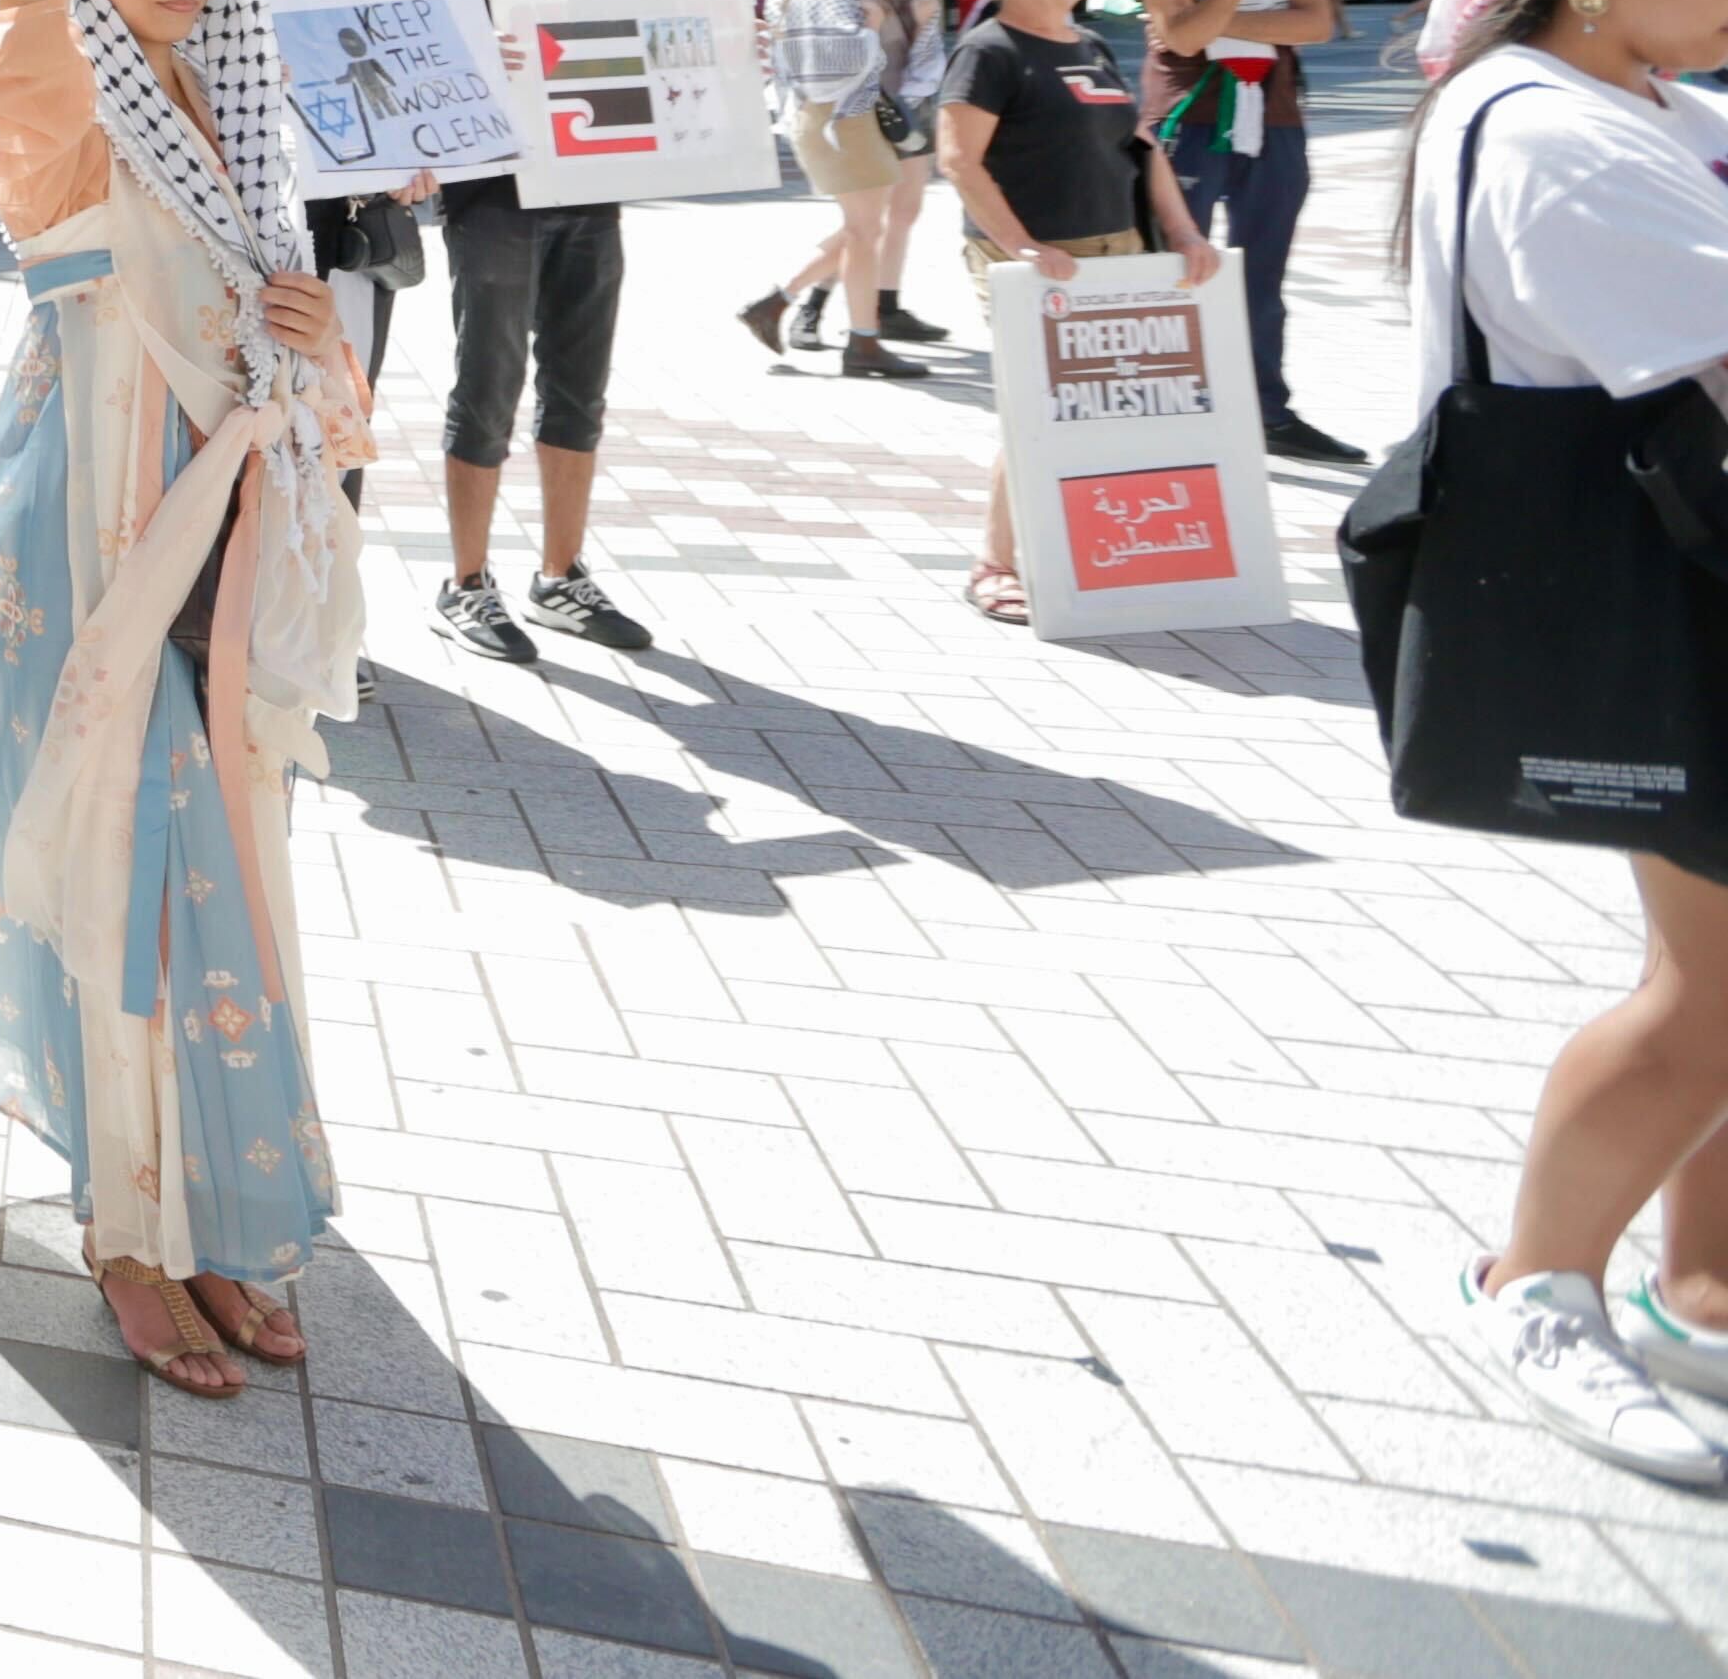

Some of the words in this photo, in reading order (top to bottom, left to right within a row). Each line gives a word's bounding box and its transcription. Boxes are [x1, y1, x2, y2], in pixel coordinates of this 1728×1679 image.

[384, 42, 449, 74] THE
[391, 72, 490, 116] WORLD
[411, 111, 513, 158] CLEAN
[1056, 314, 1190, 360] FREEDOM
[1056, 374, 1206, 421] PALESTINE
[1091, 480, 1193, 525] الحرية
[1089, 519, 1214, 569] لفلسطين
